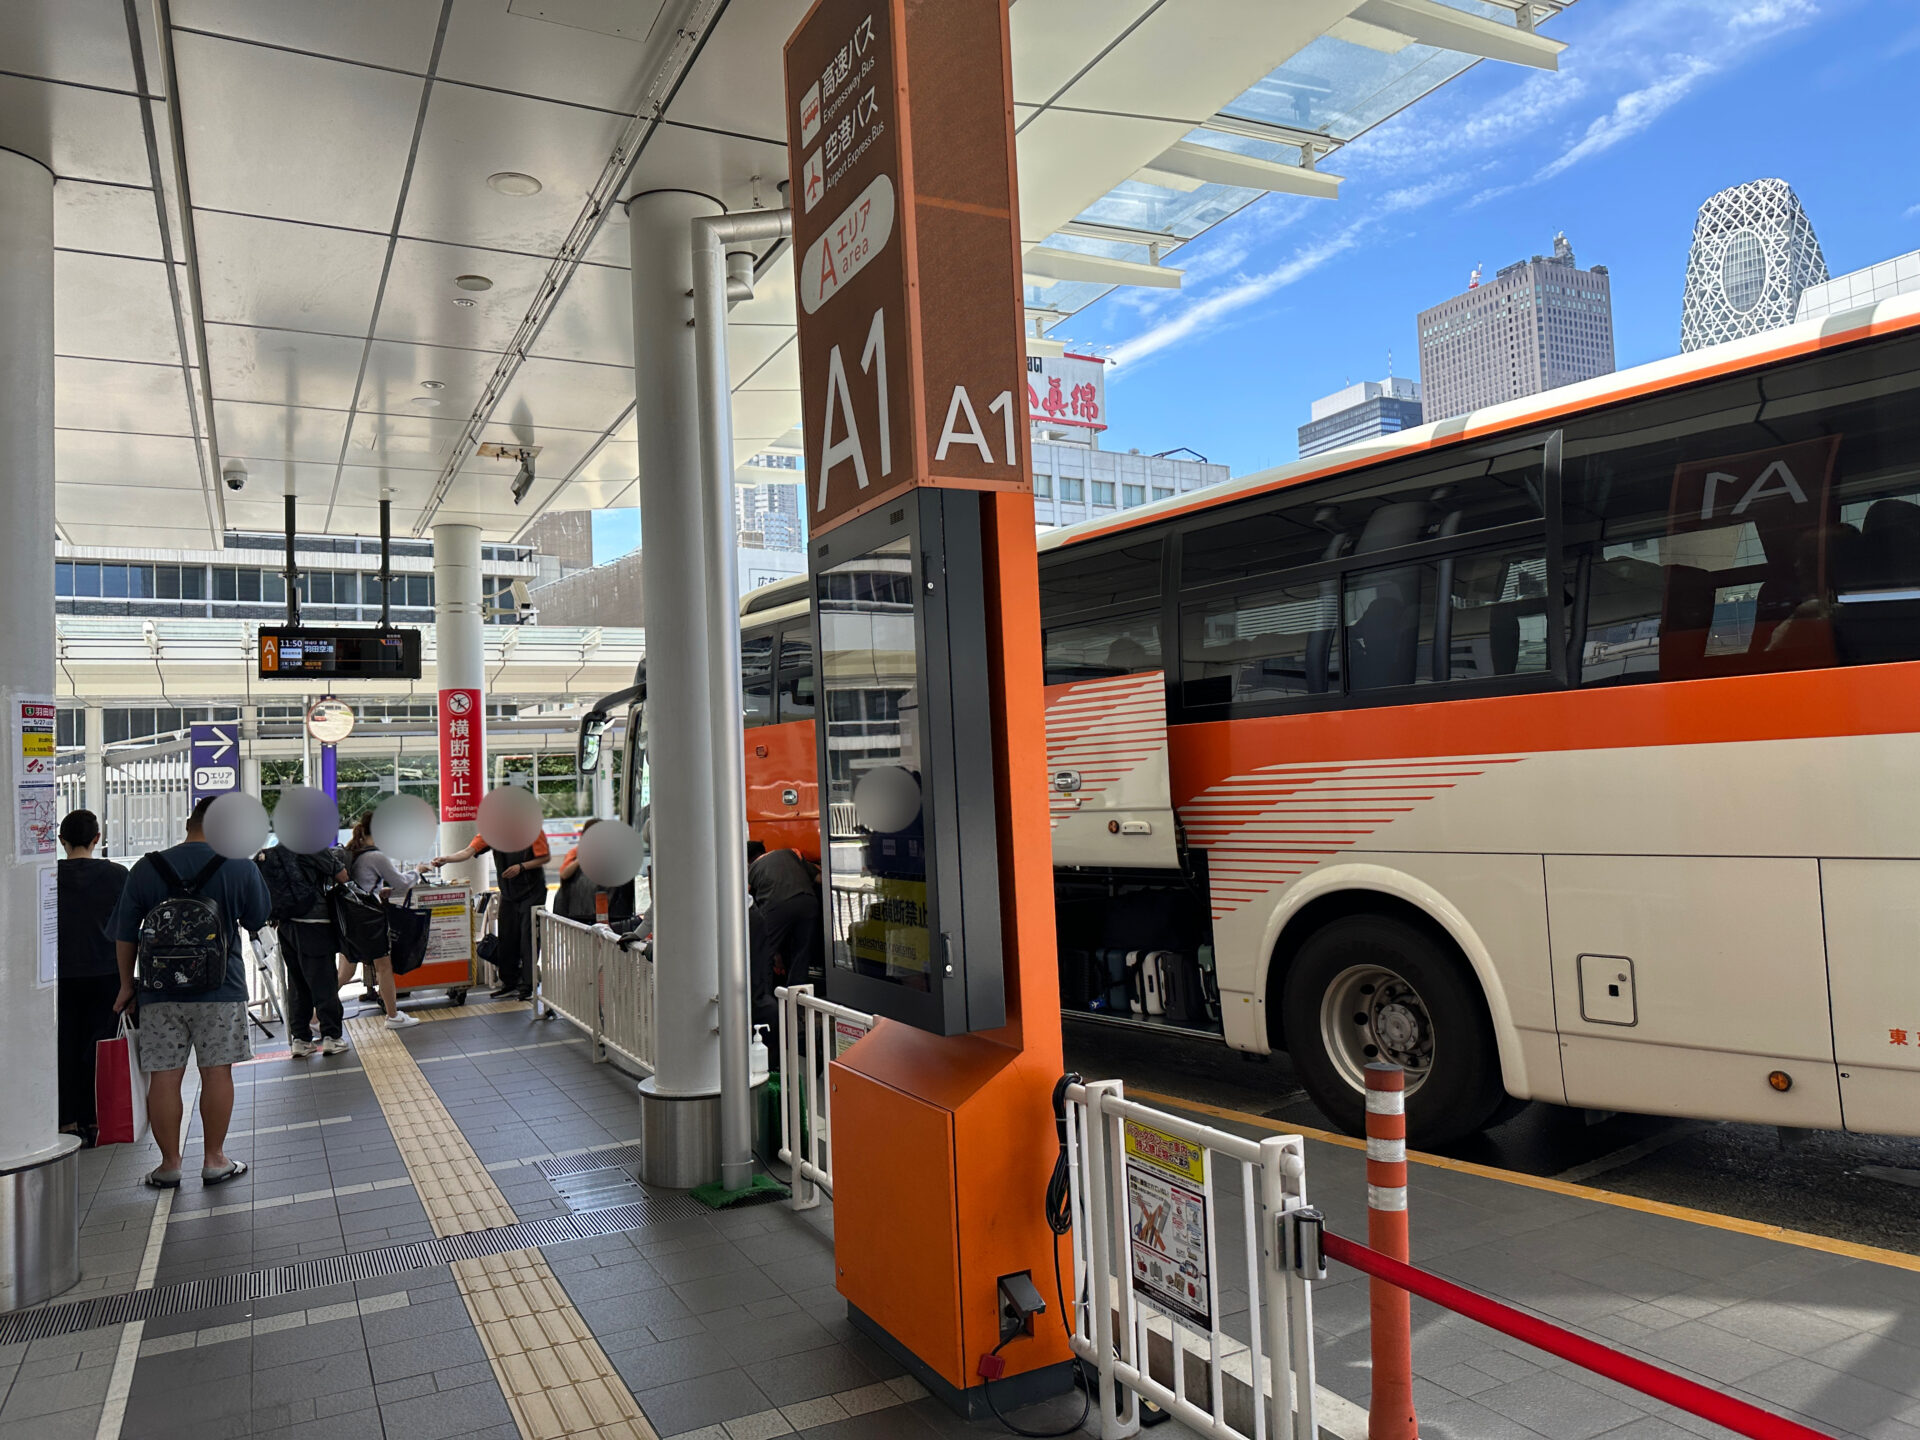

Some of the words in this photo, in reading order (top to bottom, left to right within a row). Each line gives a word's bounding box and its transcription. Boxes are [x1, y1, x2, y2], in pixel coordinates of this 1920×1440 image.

[821, 14, 876, 104] 高速バス
[823, 72, 861, 124] Expressway
[861, 56, 875, 80] Bus
[825, 85, 879, 169] 空港バス
[826, 160, 847, 191] Airport
[847, 136, 872, 168] Express
[871, 121, 884, 142] Bus
[819, 236, 838, 300] A
[837, 198, 871, 250] エリア
[842, 237, 869, 274] area
[816, 306, 892, 513] A1
[934, 385, 1017, 466] A1
[263, 640, 276, 653] A
[266, 655, 273, 667] 1
[304, 645, 334, 653] 羽田空港
[197, 772, 209, 785] D
[449, 718, 471, 797] 横断禁止
[448, 811, 476, 819] Crossing
[1888, 1028, 1920, 1047] 東
